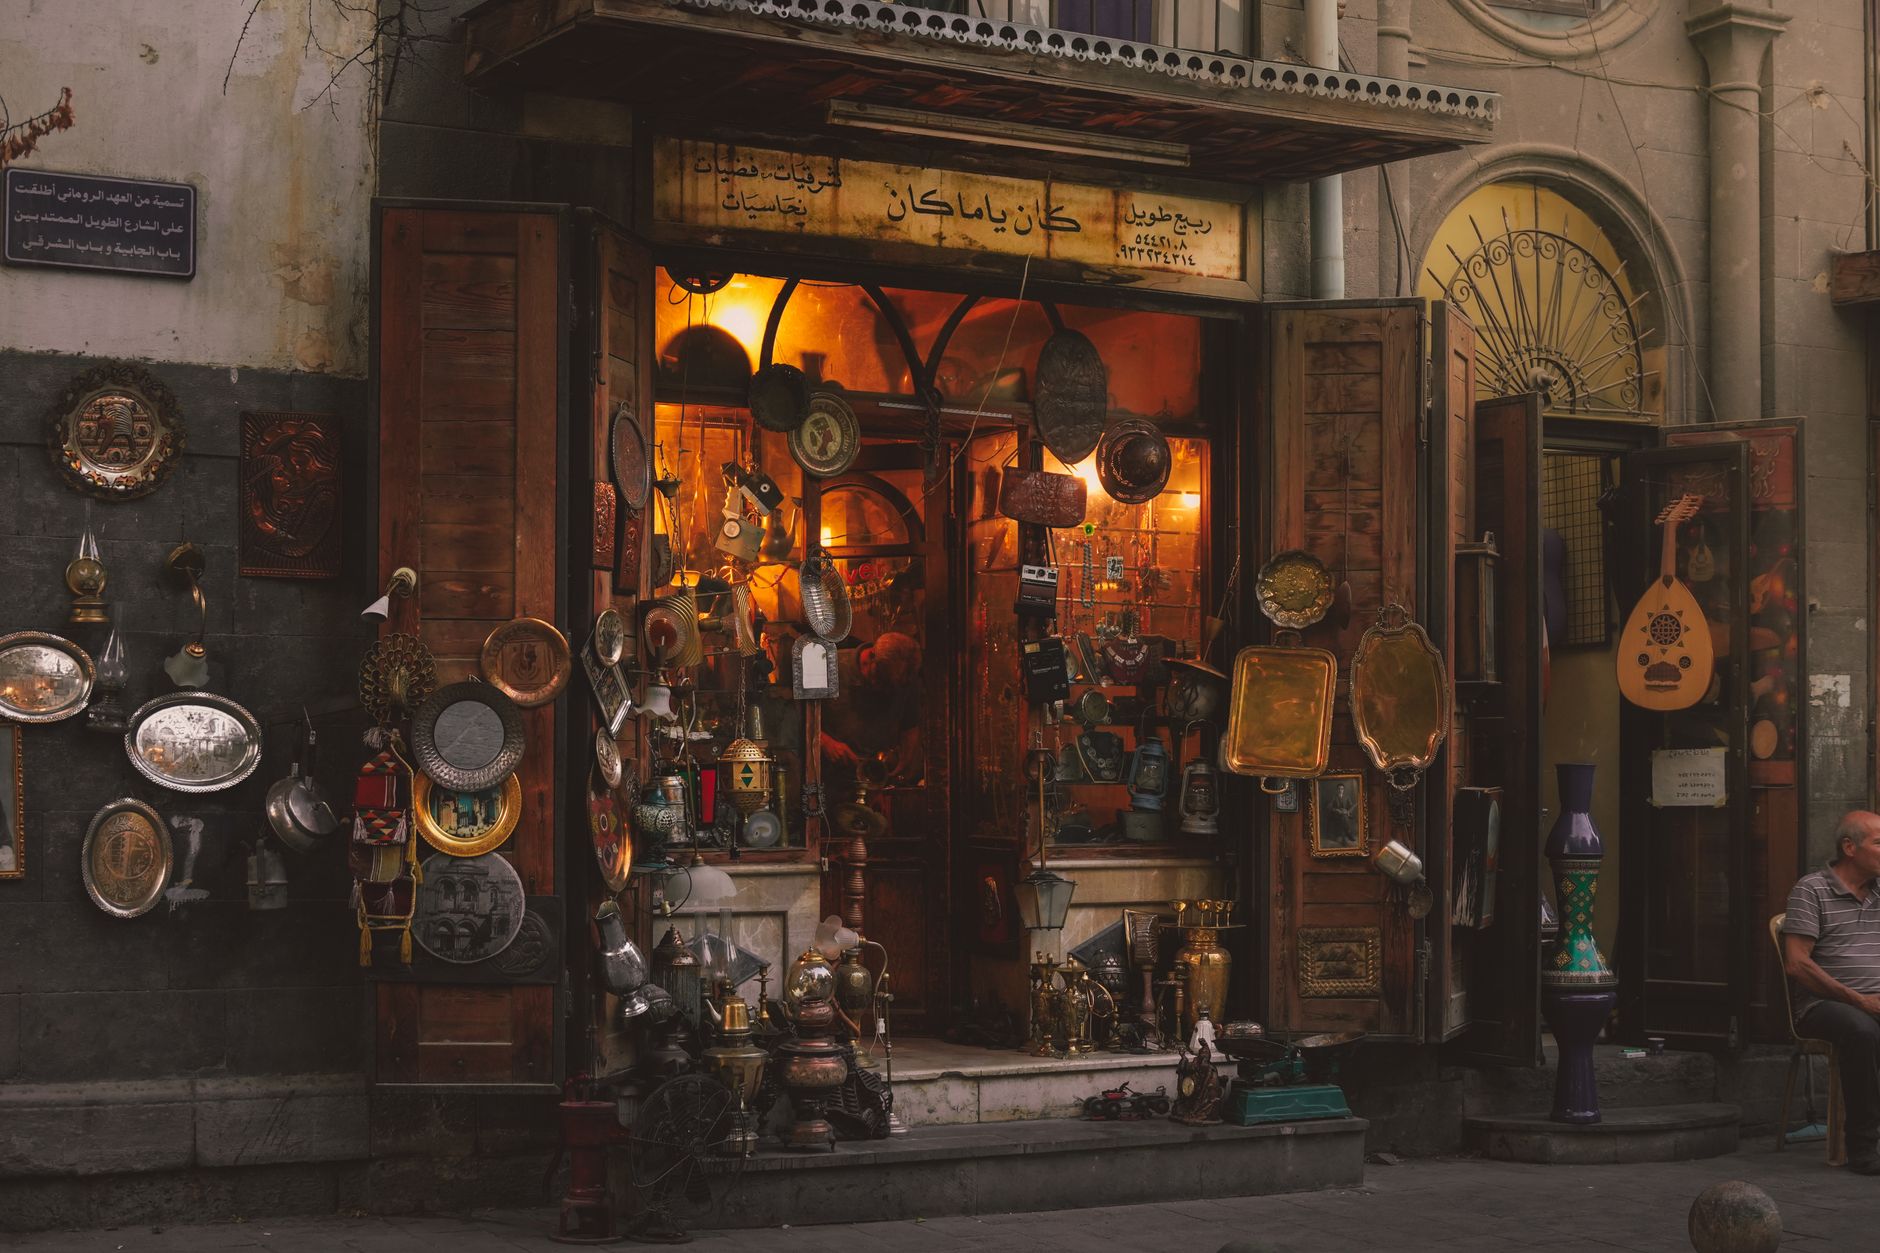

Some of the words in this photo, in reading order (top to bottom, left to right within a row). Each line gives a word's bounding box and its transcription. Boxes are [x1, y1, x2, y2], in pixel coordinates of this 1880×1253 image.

[14, 183, 56, 196] أطلقت
[57, 188, 104, 203] الروماني
[106, 192, 132, 204] العهد
[134, 195, 150, 208] من
[153, 197, 184, 208] تسمية
[886, 184, 954, 222] كان
[14, 209, 39, 222] بين
[41, 212, 83, 225] الممتد
[1013, 199, 1081, 236] كان
[1124, 203, 1172, 227] طويل
[85, 217, 122, 230] الطويل
[124, 219, 160, 233] الشارع
[161, 223, 184, 236] على
[1174, 212, 1212, 235] ربيع
[22, 235, 74, 251] الشرقي
[76, 241, 103, 255] باب
[113, 242, 155, 257] الجابية
[157, 247, 181, 261] باب
